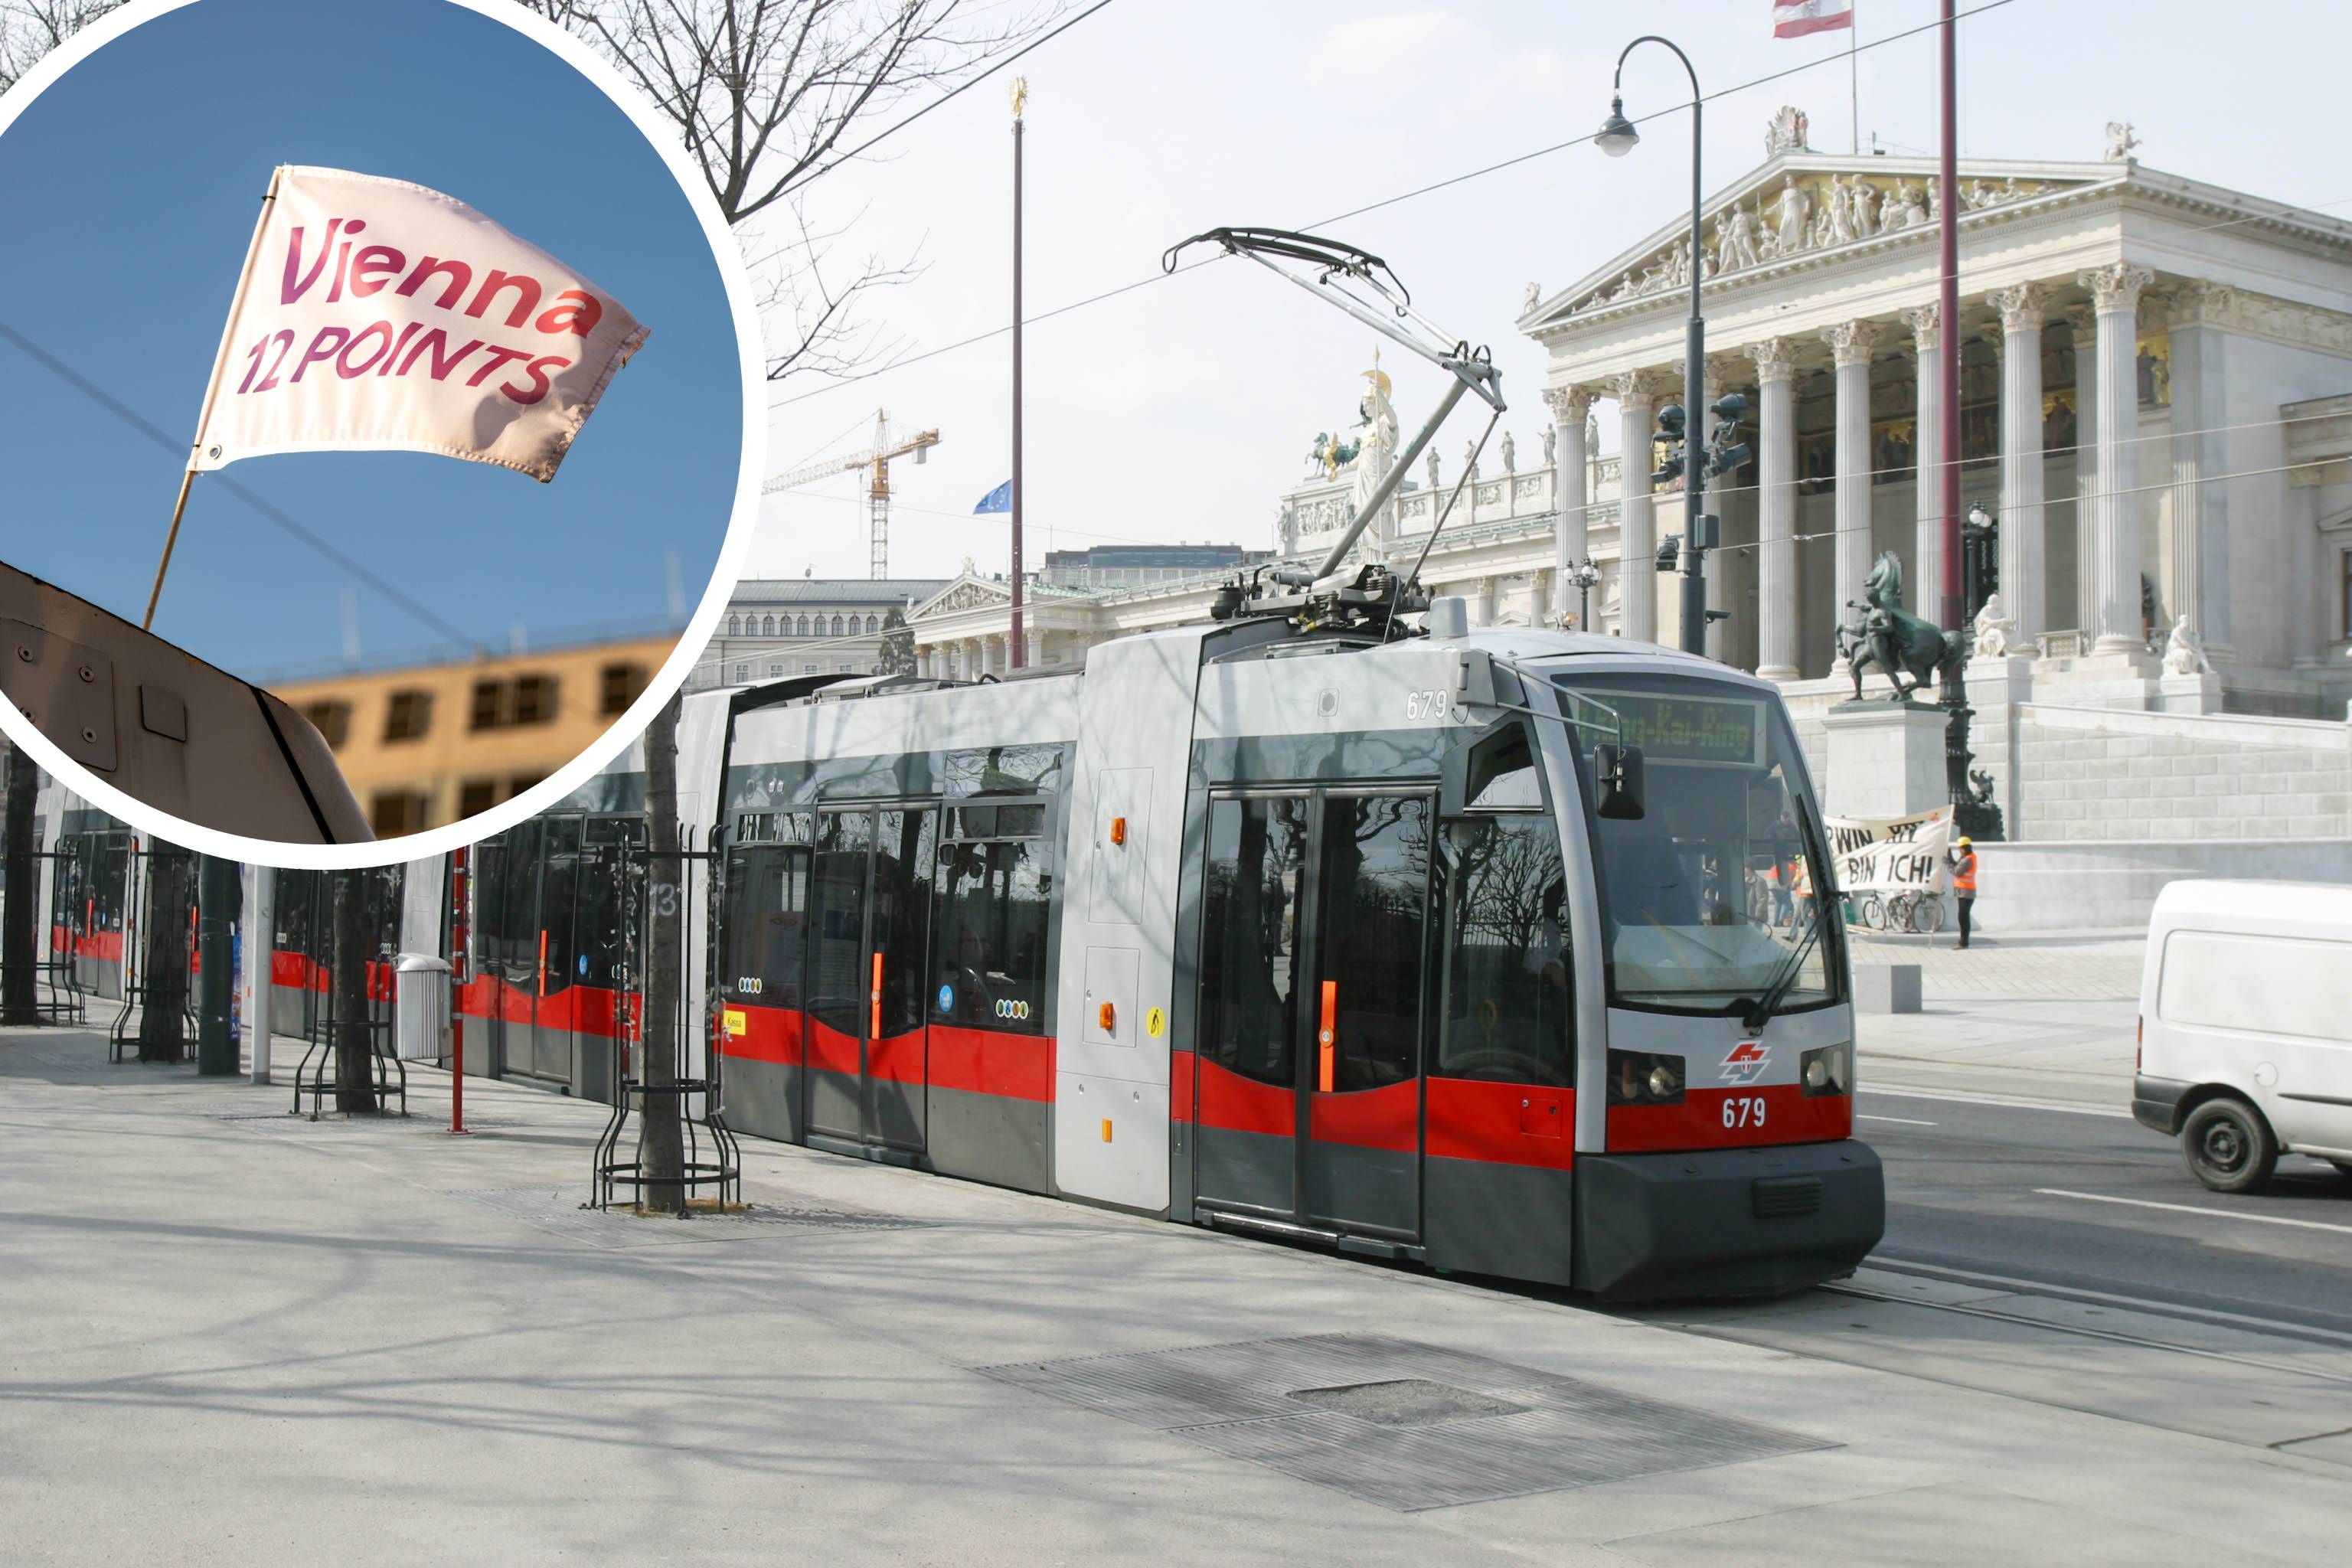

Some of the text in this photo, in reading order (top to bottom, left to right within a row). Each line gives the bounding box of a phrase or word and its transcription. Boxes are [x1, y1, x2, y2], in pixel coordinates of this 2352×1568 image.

[279, 217, 603, 339] Vienna
[237, 320, 573, 407] 12 POINTS
[1406, 688, 1448, 721] 679
[1848, 854, 1933, 884] BIN ICH!
[1723, 1097, 1766, 1129] 679
